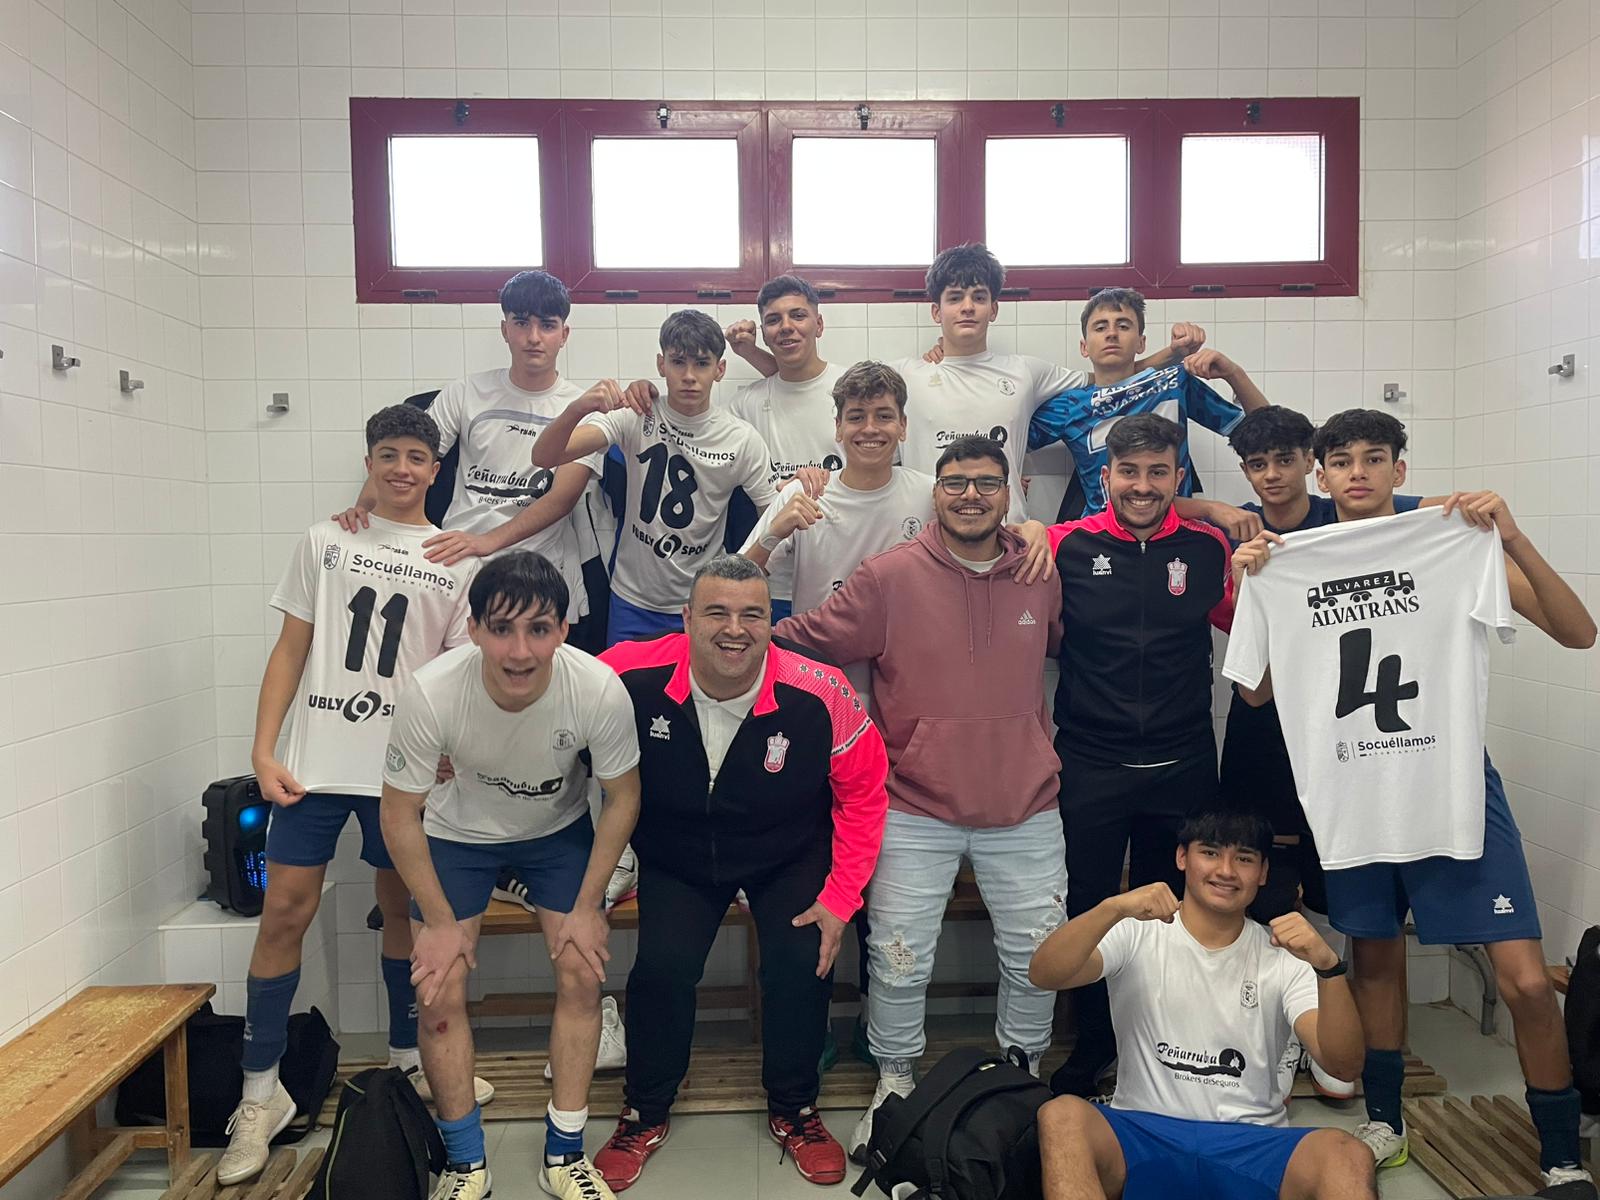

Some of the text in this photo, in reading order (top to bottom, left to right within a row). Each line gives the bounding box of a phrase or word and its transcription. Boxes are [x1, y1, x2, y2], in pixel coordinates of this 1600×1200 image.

[636, 442, 699, 530] 18
[352, 554, 455, 590] Socuéllamos
[1311, 595, 1420, 628] ALVATRANS
[345, 585, 409, 678] 11
[1335, 627, 1419, 733] 4
[308, 694, 345, 711] UBLY
[1358, 735, 1437, 751] Socuéllamos
[1157, 1042, 1218, 1065] Peñarruba
